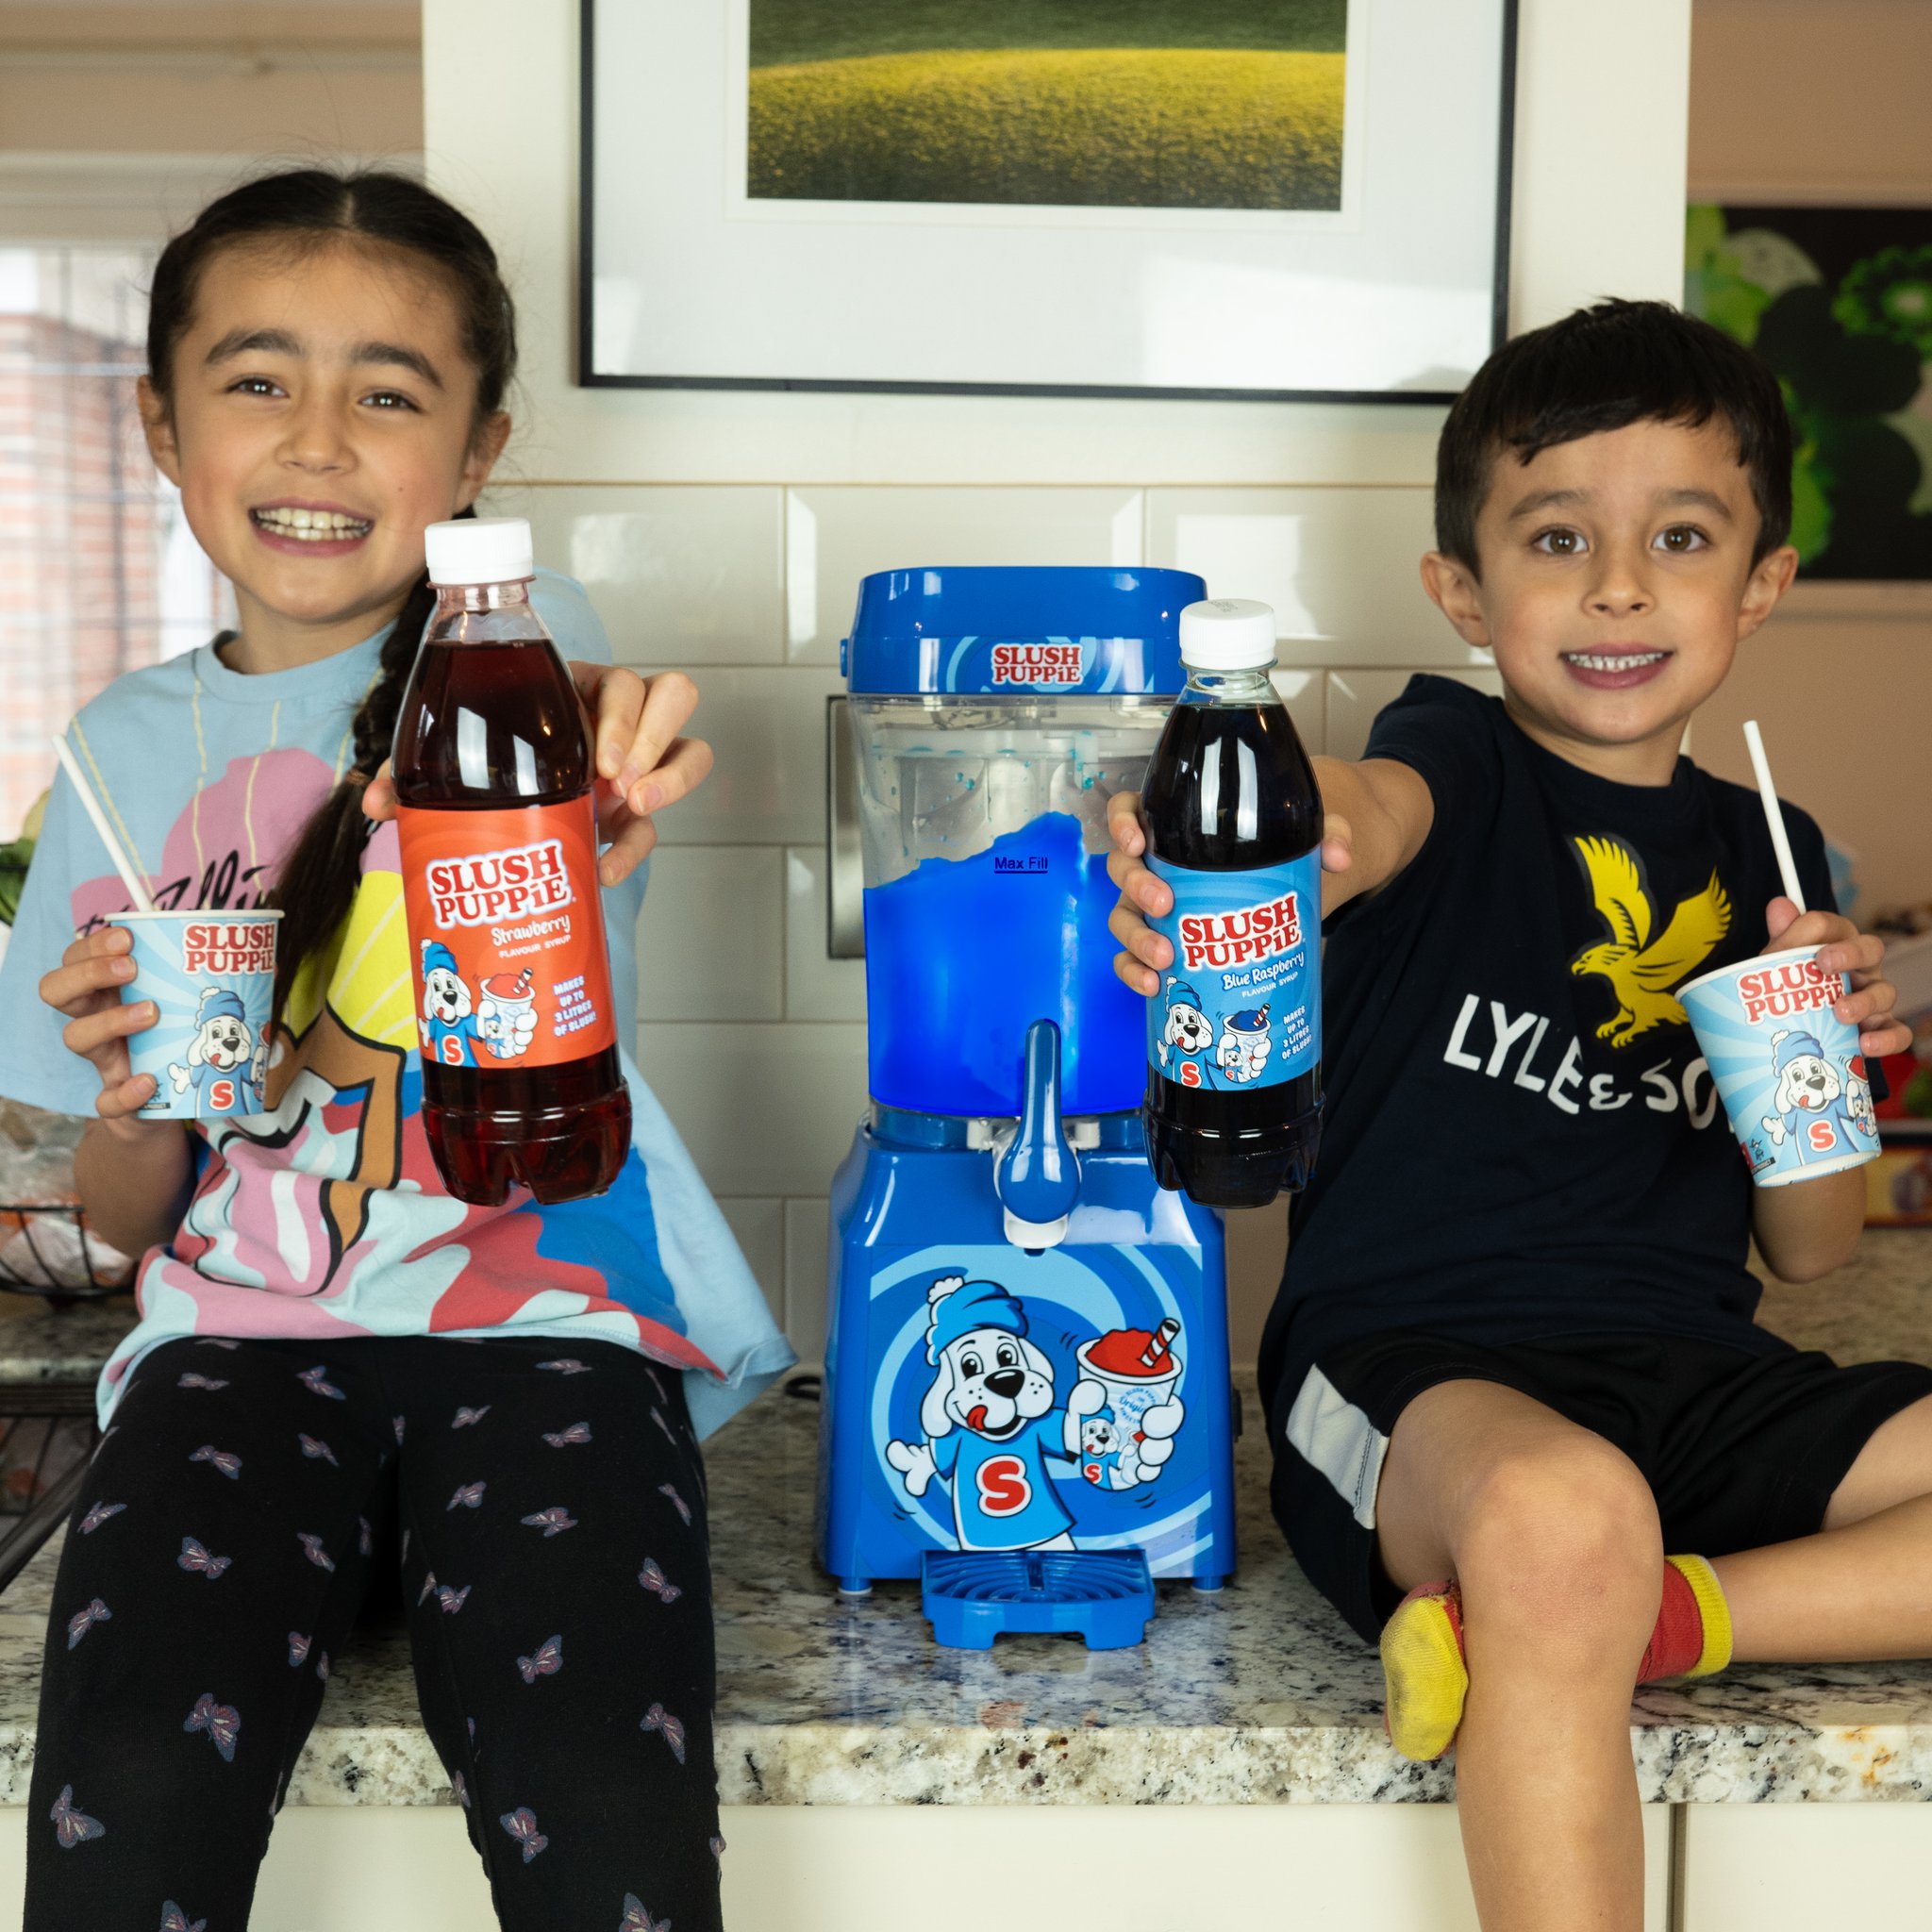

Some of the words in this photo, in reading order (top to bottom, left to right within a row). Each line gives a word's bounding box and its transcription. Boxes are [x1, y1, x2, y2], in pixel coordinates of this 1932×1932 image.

[994, 646, 1080, 665] SLUSH
[430, 845, 561, 895] SLUSH
[994, 857, 1024, 870] Max
[1028, 856, 1048, 870] Fill
[491, 914, 571, 947] Strawberry
[1181, 895, 1297, 944] SLUSH
[185, 924, 275, 950] SLUSH
[498, 943, 541, 959] FLAVOUR
[543, 934, 572, 949] SYRUP
[1223, 973, 1251, 991] Blue
[1252, 951, 1305, 985] Raspberry
[553, 974, 585, 996] MAKES
[1241, 981, 1277, 998] FLAVOUR
[1278, 971, 1299, 986] SYRUP
[554, 1011, 563, 1023] 3
[562, 999, 592, 1021] LITRES
[558, 993, 573, 1008] UP
[573, 989, 585, 1002] TO
[553, 1024, 568, 1037] OF
[568, 1010, 597, 1032] SLUSH!
[1283, 1005, 1306, 1025] MAKES
[1287, 1023, 1296, 1035] UP
[1297, 1017, 1305, 1028] TO
[1283, 1039, 1289, 1048] 3
[1289, 1024, 1309, 1045] LITRES
[443, 1037, 463, 1064] S
[1281, 1048, 1291, 1059] OF
[1442, 992, 1584, 1115] LYLE
[1588, 1073, 1634, 1111] &
[1181, 1062, 1200, 1087] S
[210, 1082, 234, 1109] S
[1809, 1123, 1835, 1150] S
[981, 1459, 1026, 1511] S
[1085, 1463, 1101, 1484] S
